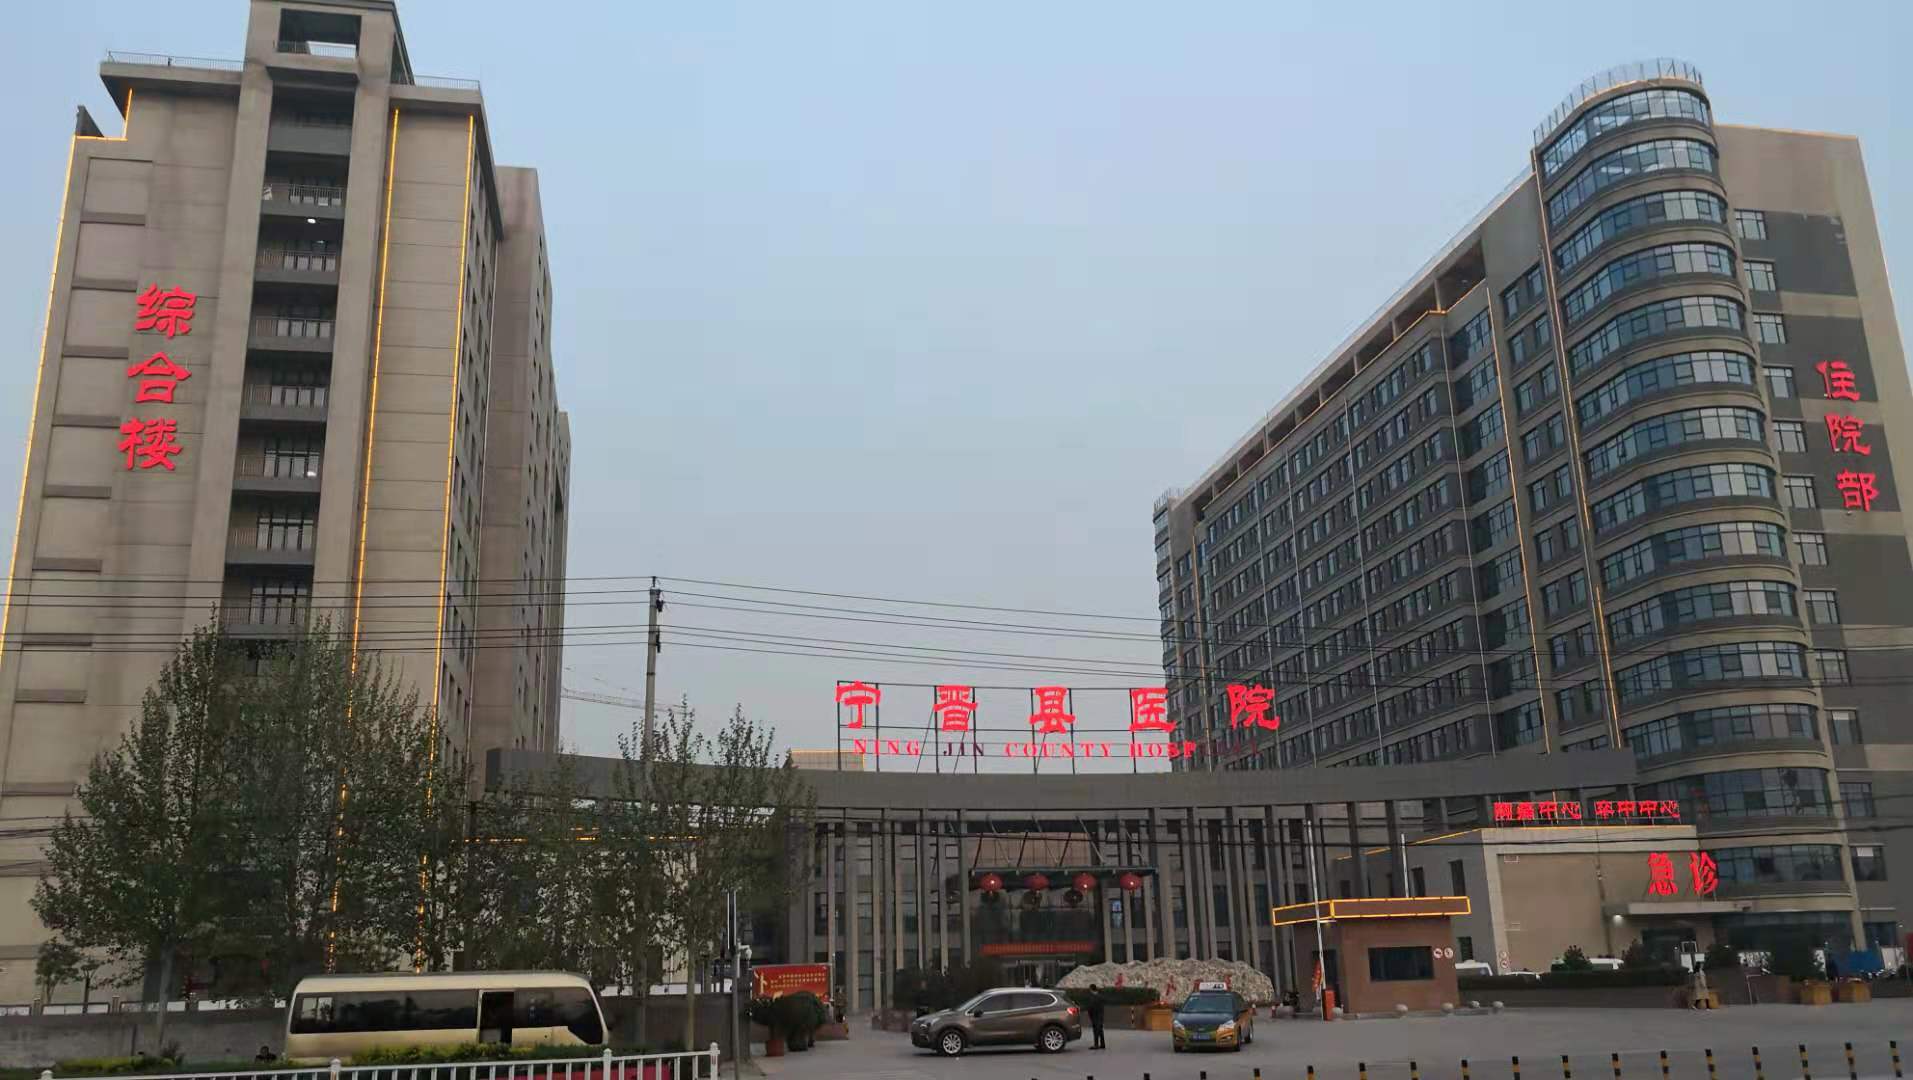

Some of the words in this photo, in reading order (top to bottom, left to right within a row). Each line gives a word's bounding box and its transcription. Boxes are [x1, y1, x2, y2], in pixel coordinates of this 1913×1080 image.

[116, 283, 197, 472] 综合楼
[1816, 360, 1879, 513] 住院部
[835, 680, 1281, 733] 宁晋县医院
[852, 739, 921, 756] NING
[943, 742, 985, 757] JIN
[1004, 740, 1111, 760] COUNTY
[1647, 851, 1719, 896] 急诊
